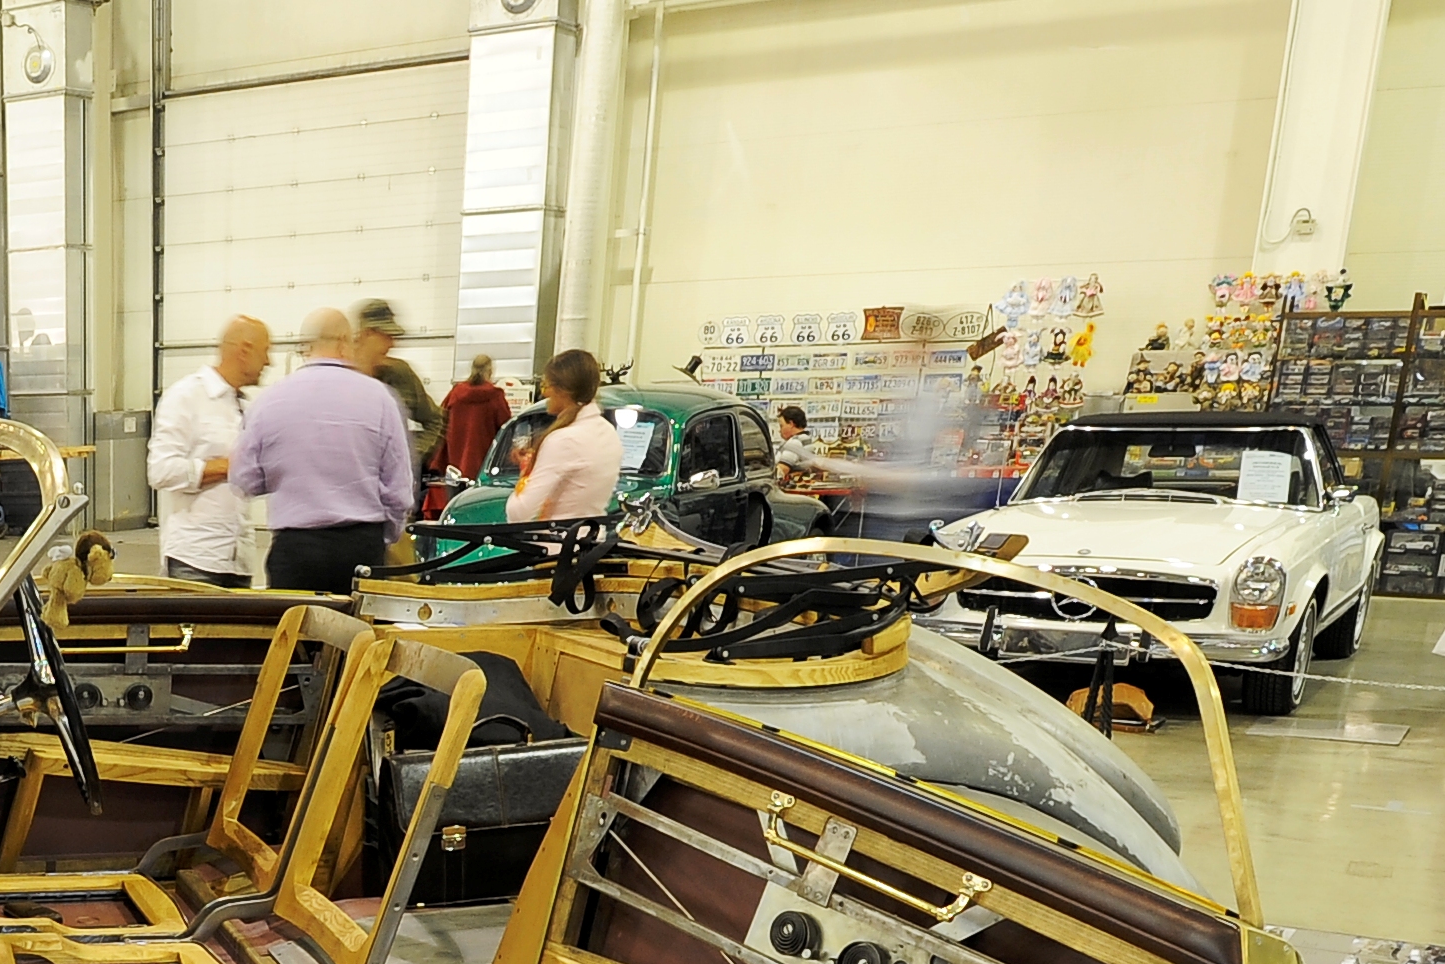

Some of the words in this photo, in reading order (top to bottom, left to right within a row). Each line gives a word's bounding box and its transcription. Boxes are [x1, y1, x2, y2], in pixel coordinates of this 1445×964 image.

[726, 332, 745, 345] 66
[759, 331, 779, 344] 66
[796, 330, 816, 343] 66
[831, 328, 851, 341] 66
